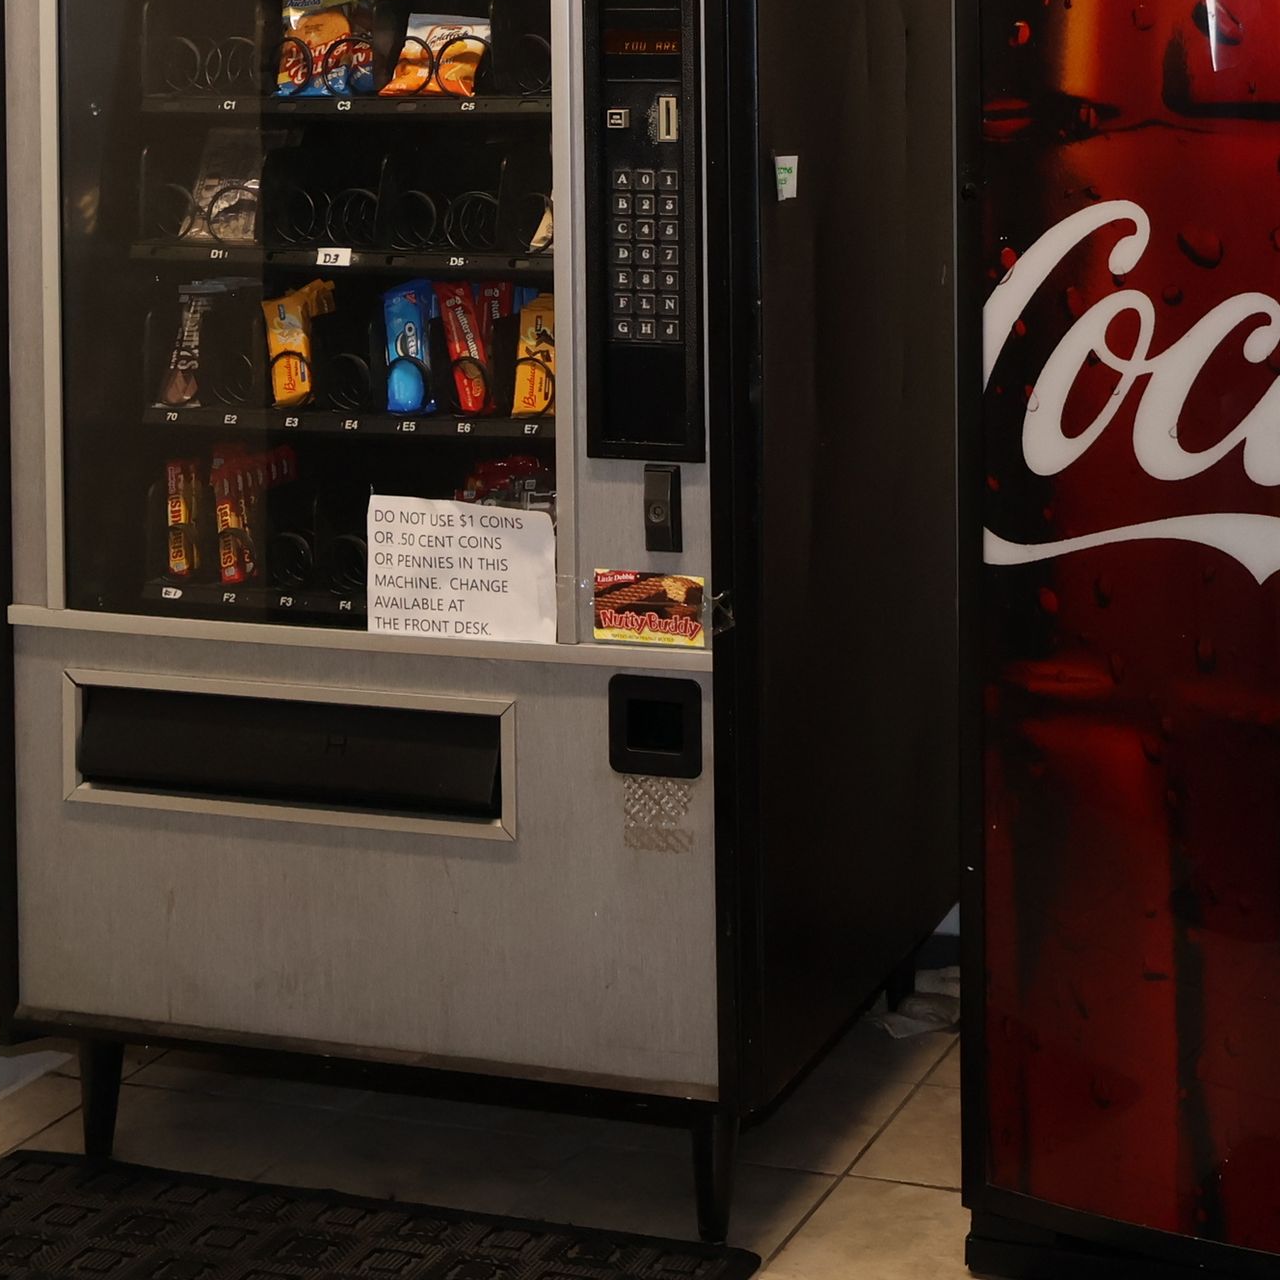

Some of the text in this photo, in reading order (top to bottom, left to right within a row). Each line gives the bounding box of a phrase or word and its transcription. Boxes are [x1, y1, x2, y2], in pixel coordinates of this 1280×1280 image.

[625, 42, 678, 51] YOU ARE
[223, 101, 236, 111] C1
[337, 101, 351, 111] C3
[461, 102, 475, 111] C5
[618, 175, 627, 183] A
[210, 249, 223, 259] D1
[323, 253, 339, 264] D3
[449, 257, 464, 266] D5
[224, 415, 237, 425] E2
[285, 418, 299, 427] E3
[344, 420, 358, 430] E4
[402, 422, 416, 431] E5
[457, 423, 471, 433] E6
[524, 424, 538, 434] E7
[375, 510, 523, 529] DO NOT USE $1 COINS
[375, 531, 502, 549] OR .50 CENT COINS
[375, 553, 508, 571] OR PENNIES IN THIS
[375, 575, 508, 593] MACHINE. CHANGE
[223, 593, 236, 603] F2
[280, 597, 293, 606] F3
[339, 601, 352, 610] F4
[375, 596, 464, 612] AVAILABLE AT
[375, 617, 491, 636] THE FRONT DESK.
[601, 610, 701, 640] Nutty Buddy
